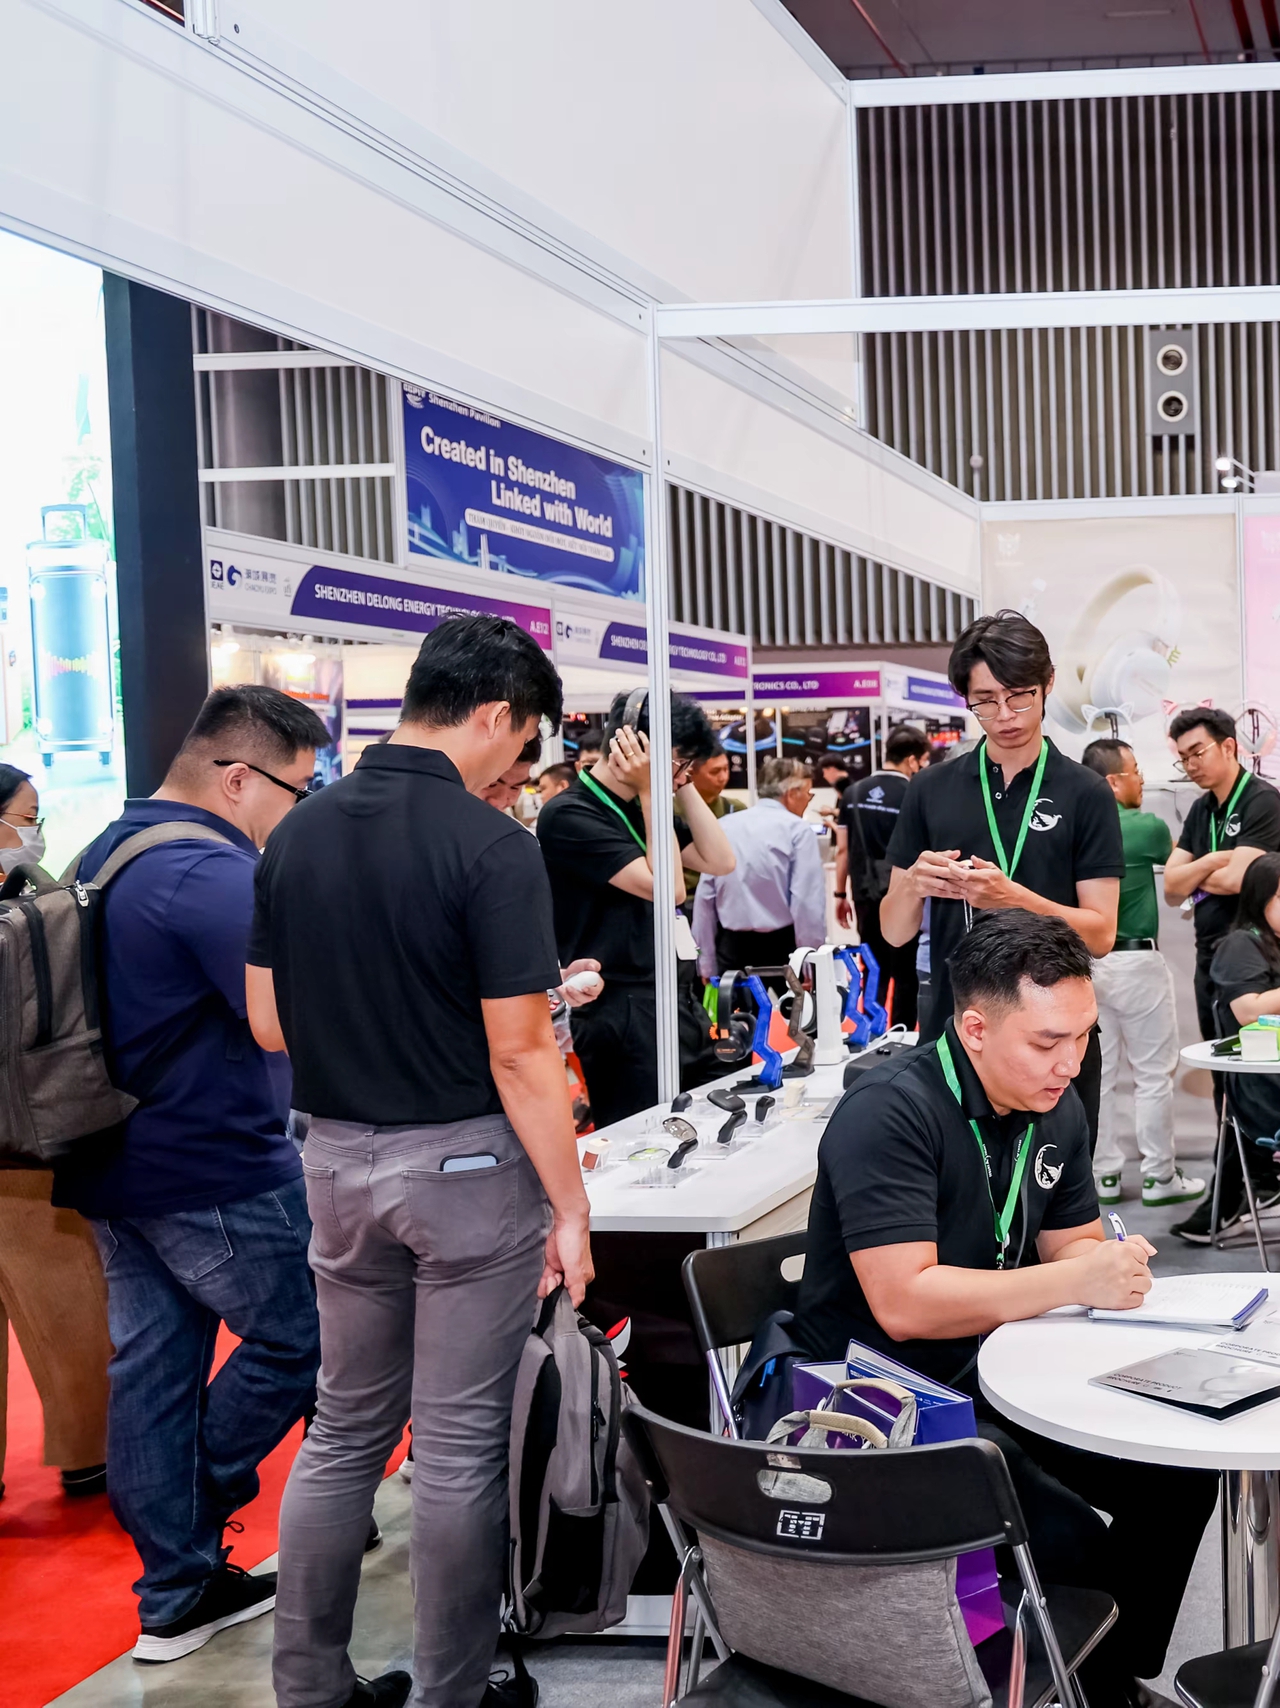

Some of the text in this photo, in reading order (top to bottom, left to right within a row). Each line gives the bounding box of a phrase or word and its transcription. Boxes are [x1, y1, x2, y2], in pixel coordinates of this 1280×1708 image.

[420, 425, 577, 500] Created in Shenzhen
[490, 480, 613, 538] Linked with World
[314, 583, 366, 606] SHENZHEN
[366, 592, 403, 612] DELONG
[403, 598, 436, 616] ENERGY
[803, 680, 819, 691] LTD
